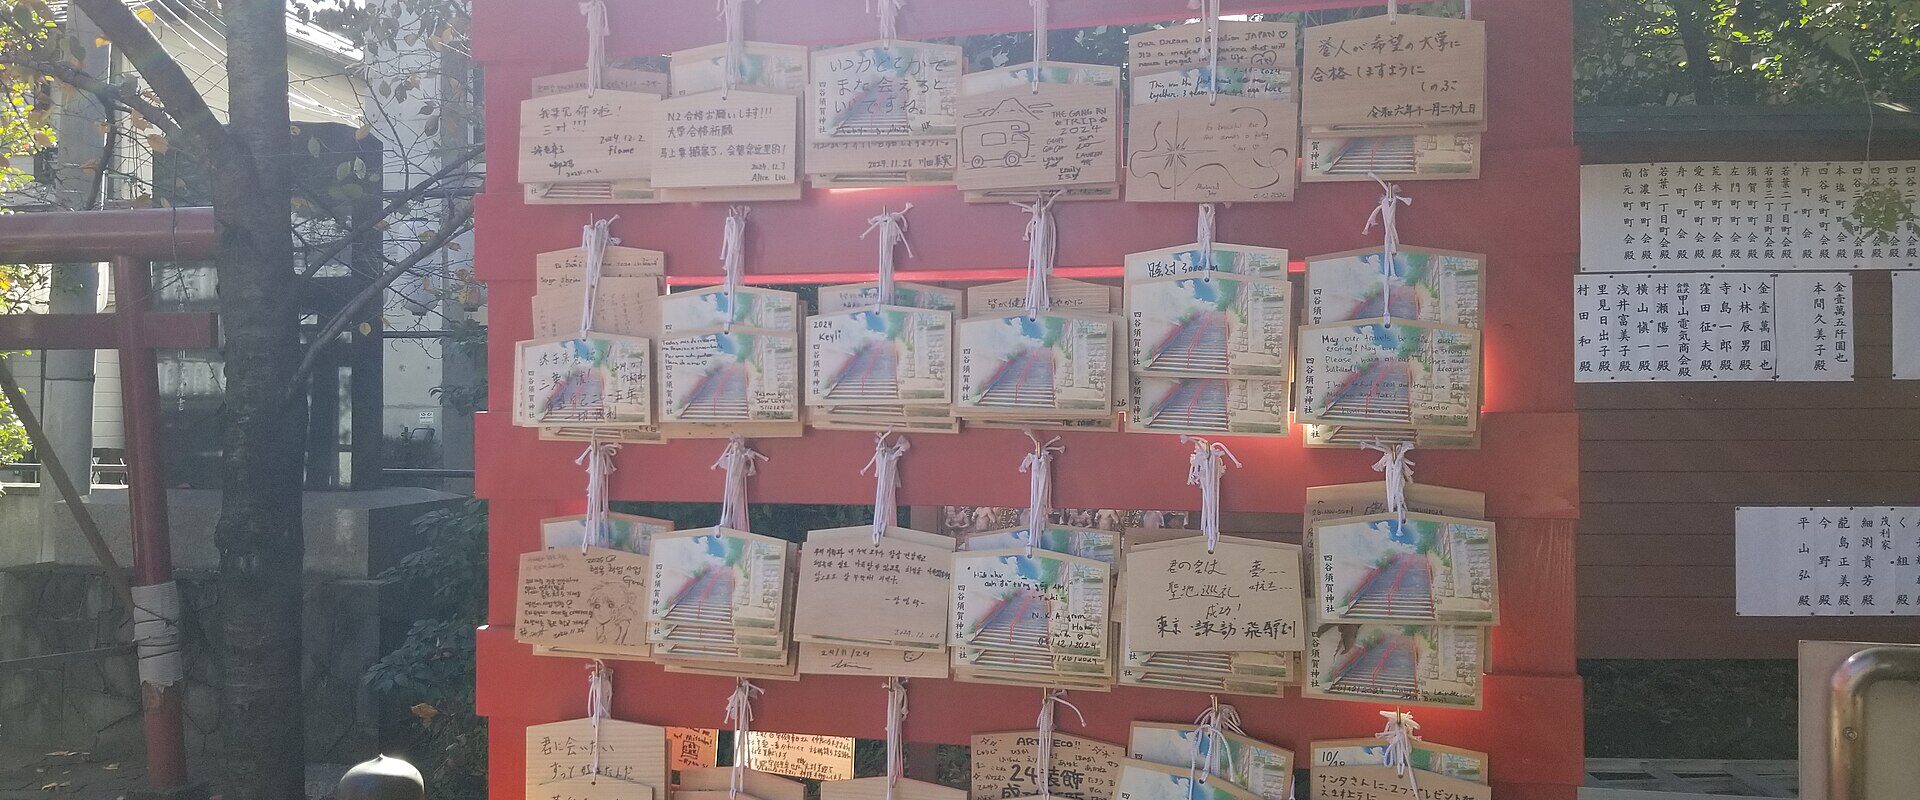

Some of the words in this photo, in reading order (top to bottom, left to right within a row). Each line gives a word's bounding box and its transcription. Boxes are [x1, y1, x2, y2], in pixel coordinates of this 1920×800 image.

[1052, 111, 1066, 119] THE
[1068, 108, 1093, 118] GANG
[1310, 62, 1426, 82] 合格しますように
[1060, 125, 1103, 135] 2024
[1622, 168, 1636, 261] 南元町町会殿
[1639, 168, 1653, 260] 信濃町町会殿
[1658, 167, 1672, 260] 若葉一丁目町会殿
[1676, 166, 1689, 260] 舟町町会殿
[1693, 165, 1706, 259] 愛住町町会殿
[1711, 165, 1723, 259] 荒木町町会殿
[1730, 166, 1742, 259] 左門町町会殿
[1747, 166, 1759, 259] 須賀町町会殿
[1764, 166, 1776, 259] 若葉三丁目町会殿
[1781, 166, 1793, 259] 若葉二丁目町会殿
[1801, 166, 1813, 259] 片町町会殿
[1818, 167, 1831, 259] 四谷坂町町会殿
[1133, 311, 1142, 366] 四谷須賀神社
[1321, 334, 1339, 346] May
[1577, 284, 1594, 373] 村田和殿
[1596, 284, 1612, 372] 里見日出子殿
[1656, 283, 1671, 372] 村瀬陽一殿
[1699, 282, 1714, 372] 窪田征夫殿
[1718, 282, 1734, 371] 寺島一郎殿
[1738, 282, 1754, 371] 小林辰男殿
[1812, 281, 1827, 371] 本間久美子殿
[1304, 357, 1314, 414] 四谷須賀神社
[1323, 555, 1336, 614] 四谷須賀神社
[1798, 516, 1811, 607] 平山弘殿
[1818, 516, 1832, 606] 今野殿
[1311, 631, 1321, 688] 四谷須賀神社
